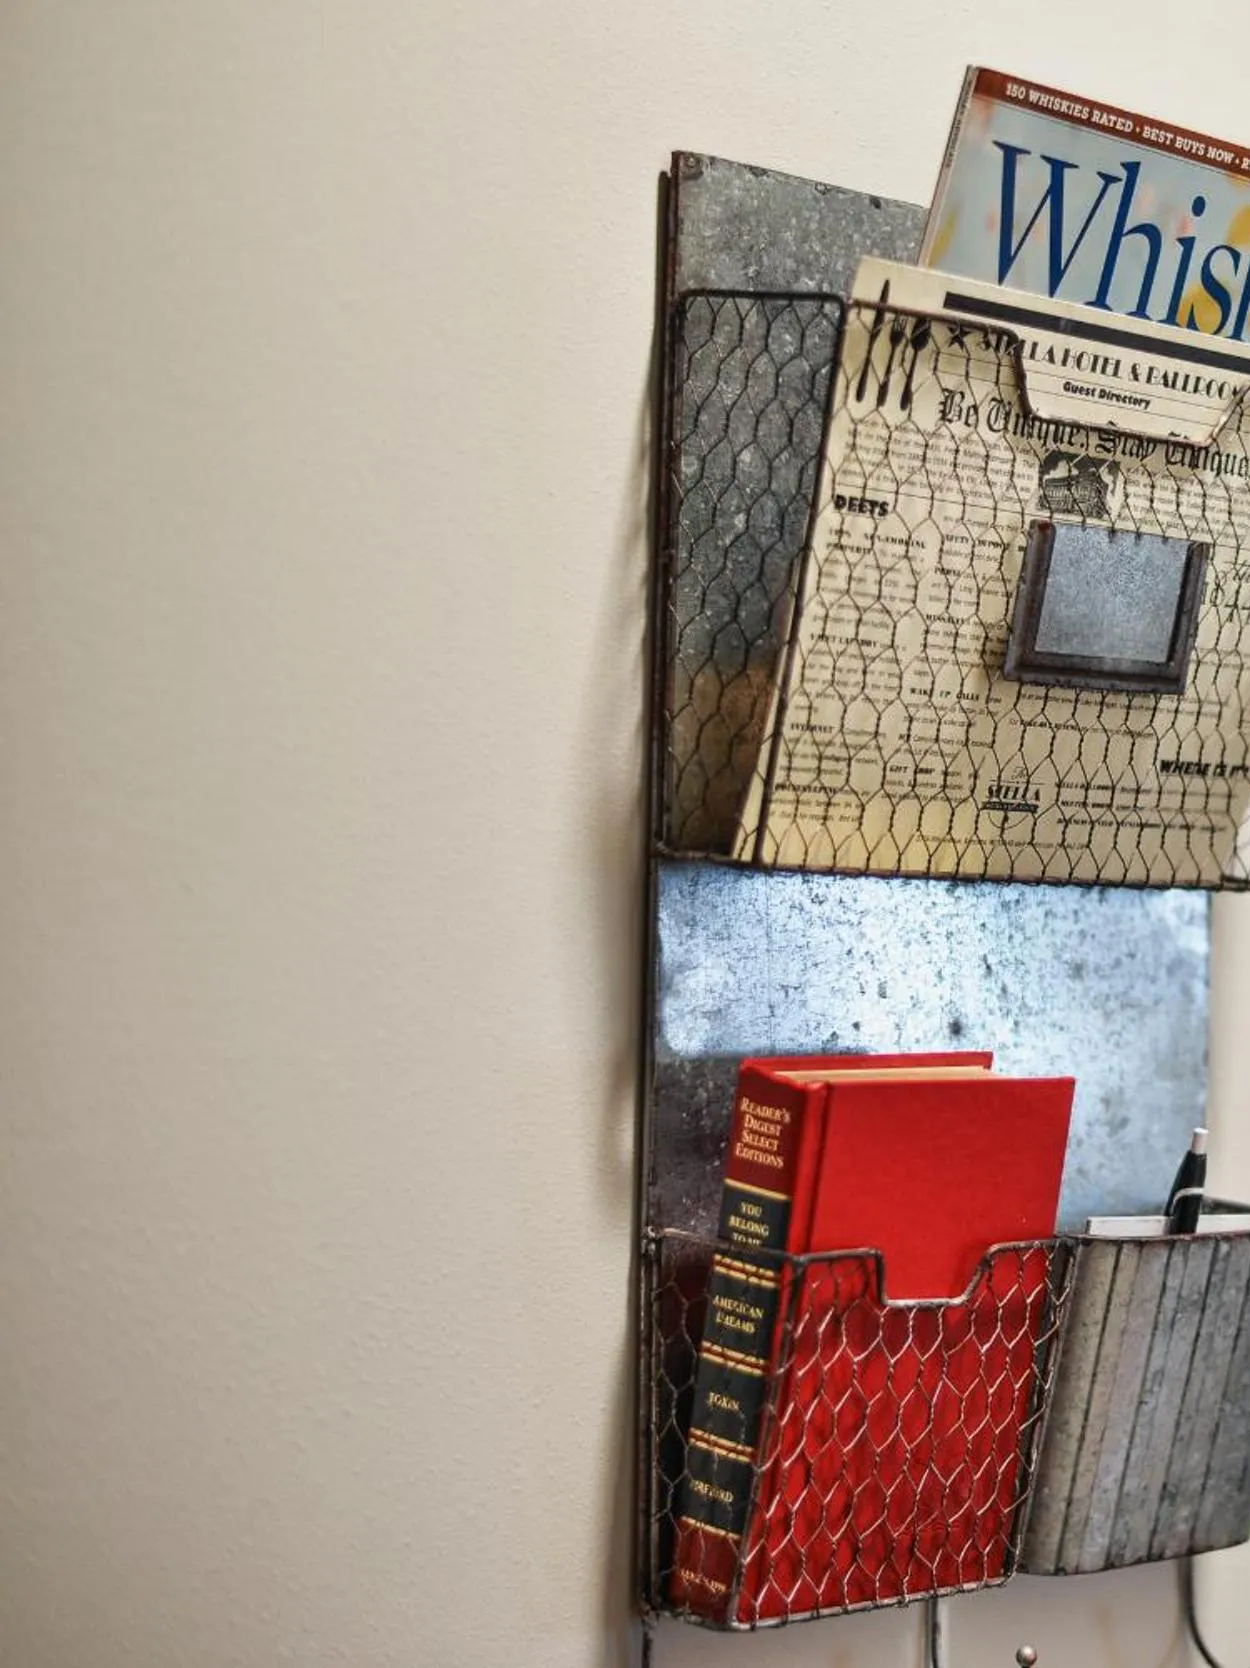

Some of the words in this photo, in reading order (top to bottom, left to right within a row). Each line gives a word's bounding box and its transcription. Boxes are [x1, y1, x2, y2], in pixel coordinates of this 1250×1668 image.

[1006, 83, 1025, 100] 150
[1028, 90, 1090, 120] WHISKIES
[1091, 109, 1134, 133] RATED
[1142, 126, 1173, 146] BEST
[1174, 136, 1205, 156] BUYS
[1206, 145, 1235, 164] NOW
[1061, 347, 1122, 378] HOTEL
[938, 388, 977, 427] Be
[1063, 381, 1096, 402] Guest
[1098, 385, 1150, 410] Directory
[834, 494, 889, 517] DEETS
[1160, 759, 1211, 777] WHERE
[740, 1097, 791, 1124] READER'S
[744, 1113, 782, 1136] DIGEST
[741, 1129, 779, 1151] SELECT
[735, 1142, 784, 1169] EDITIONS
[740, 1201, 762, 1218] YOU
[729, 1214, 769, 1238] BELONG
